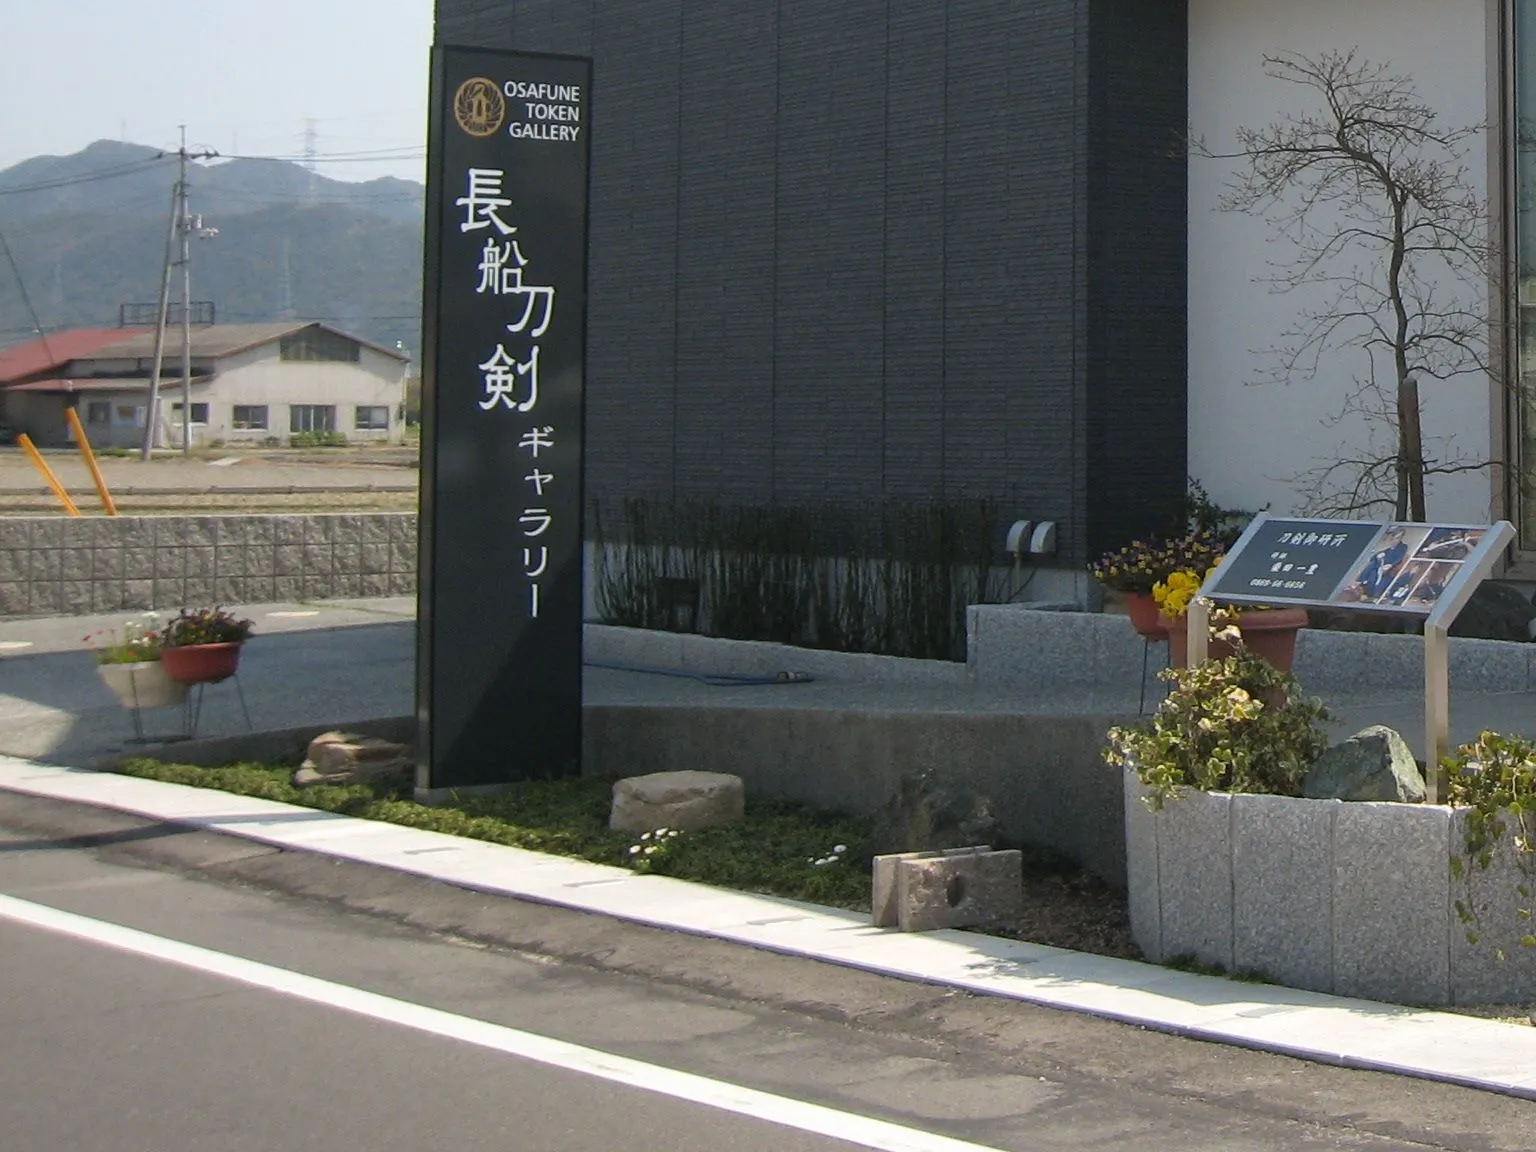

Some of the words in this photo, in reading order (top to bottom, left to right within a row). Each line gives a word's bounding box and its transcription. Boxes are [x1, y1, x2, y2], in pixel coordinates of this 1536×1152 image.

[504, 80, 580, 102] OSAFUNE
[525, 103, 580, 122] TOKEN
[509, 122, 580, 141] GALLERY
